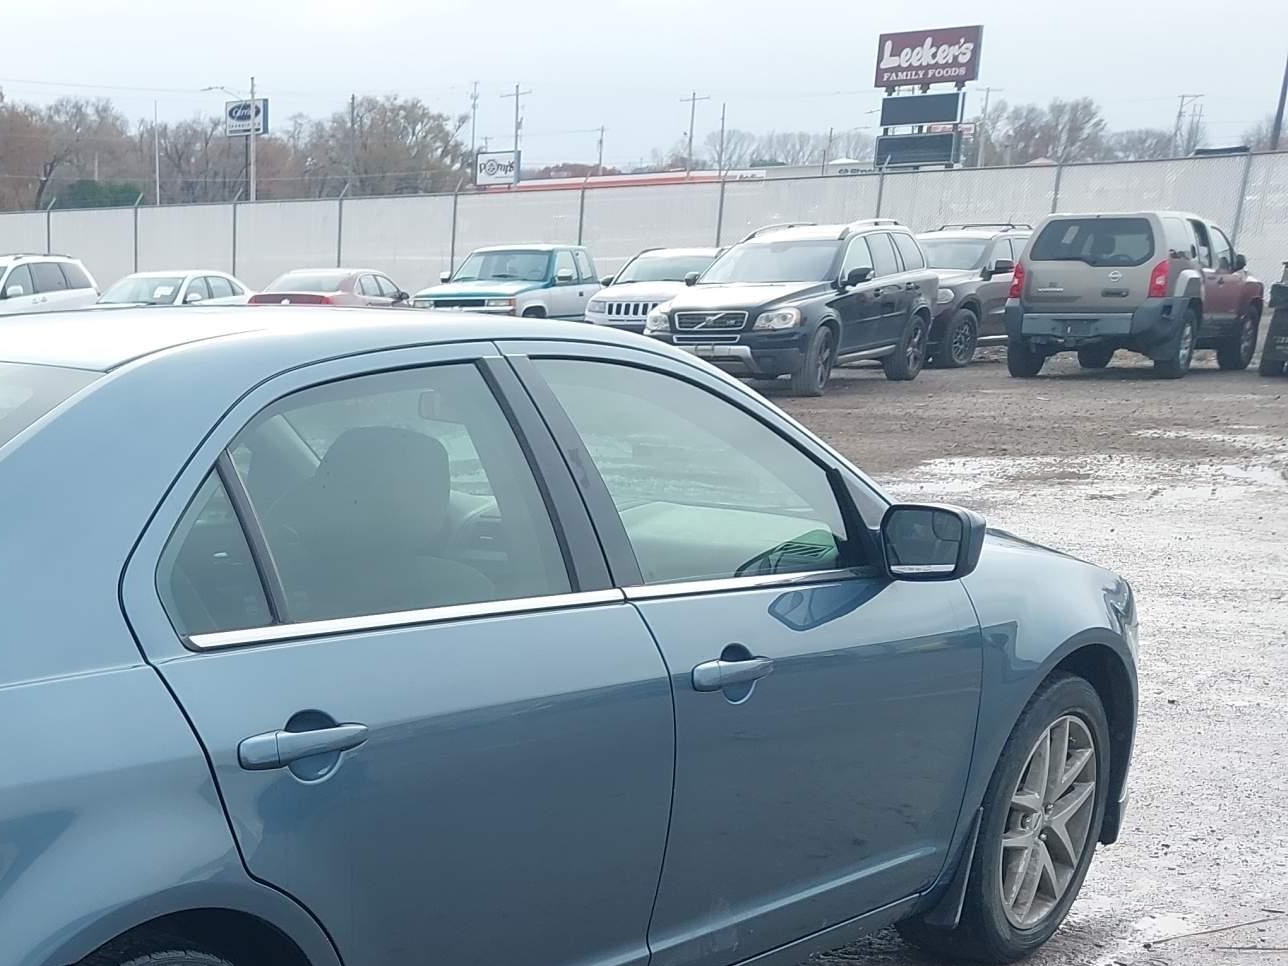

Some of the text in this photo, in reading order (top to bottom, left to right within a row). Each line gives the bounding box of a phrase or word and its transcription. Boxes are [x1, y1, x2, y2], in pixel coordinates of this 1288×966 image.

[879, 37, 974, 69] Leeker's
[883, 67, 966, 81] FAMILY FOODS
